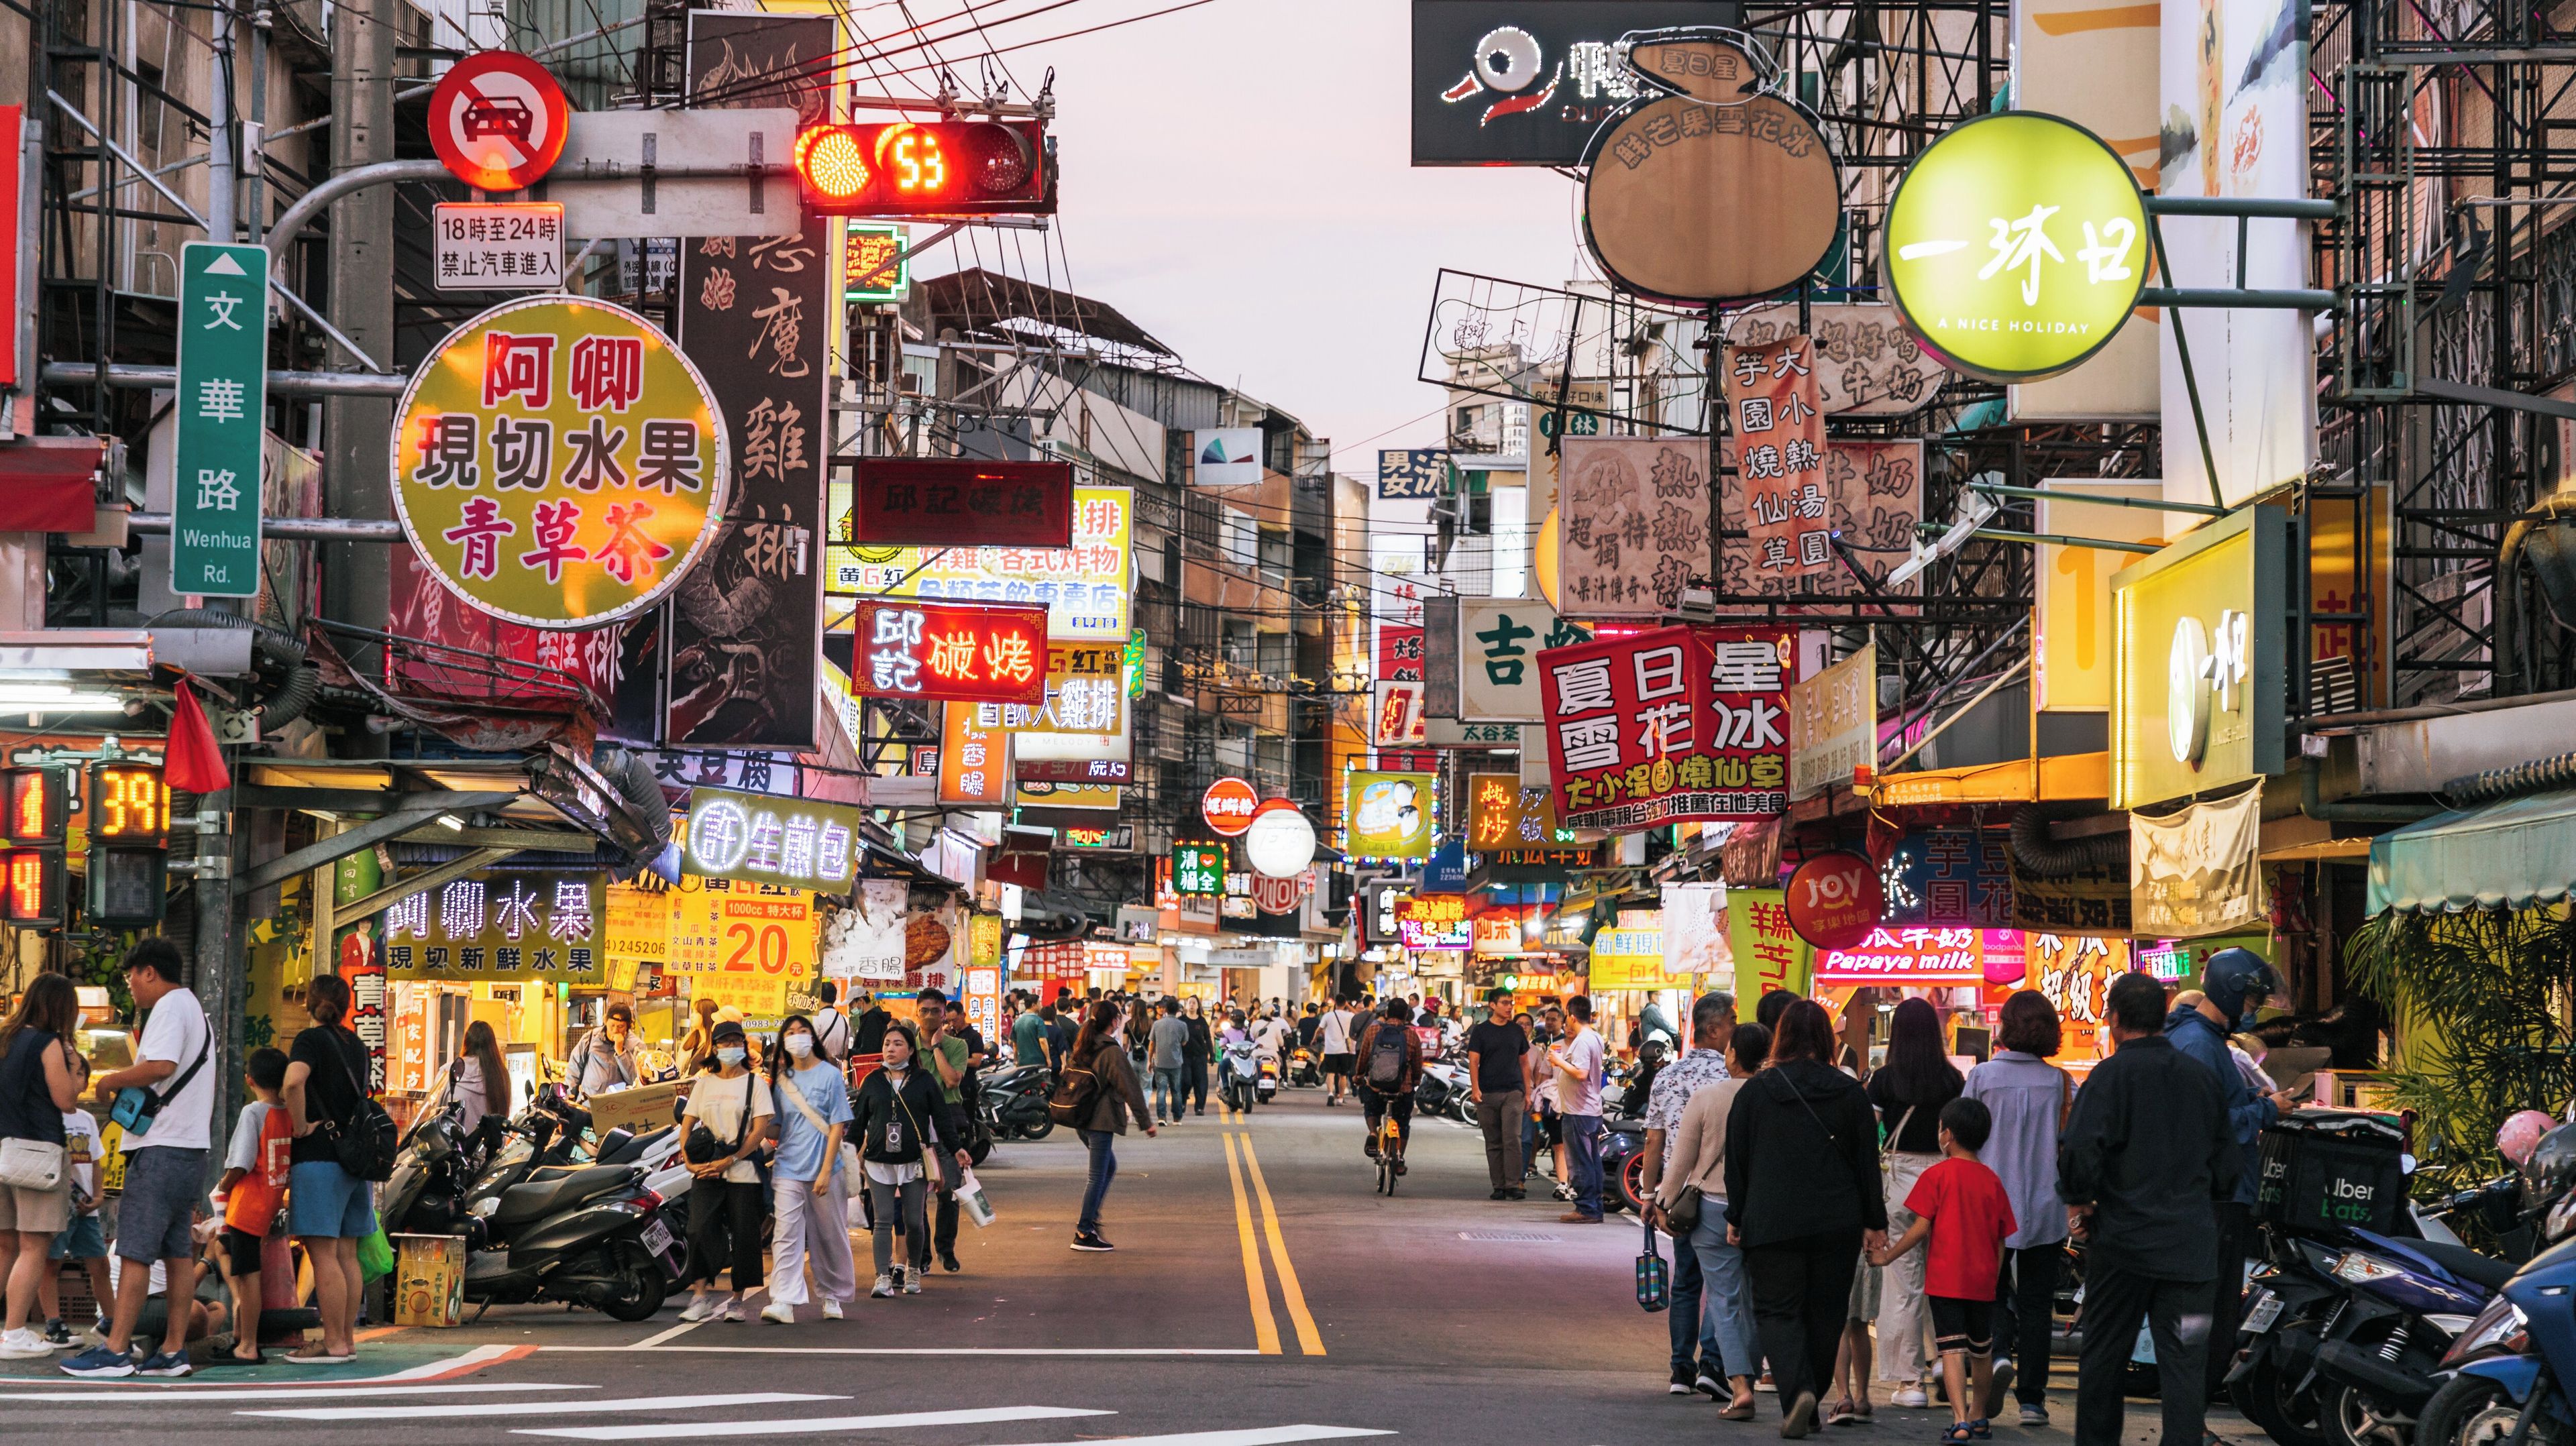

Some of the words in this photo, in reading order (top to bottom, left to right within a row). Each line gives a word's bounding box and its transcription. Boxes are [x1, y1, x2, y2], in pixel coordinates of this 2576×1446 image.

[1660, 48, 1738, 80] 夏日星
[1613, 105, 1815, 170] 鮮芒果雪花冰
[896, 136, 944, 189] 53
[441, 215, 556, 242] 18時至24時
[441, 250, 557, 277] 禁止汽車進入
[1898, 203, 2137, 307] 一沐日
[1938, 318, 1948, 329] A
[1957, 319, 2000, 331] NICE
[2008, 321, 2089, 335] HOLIDAY
[482, 331, 643, 412] 阿卿
[197, 290, 244, 512] 文華路
[414, 414, 702, 495] 現切水果
[1382, 450, 1411, 496] 男女
[1772, 346, 1831, 567] 大小熱湯圓
[183, 529, 252, 549] Wenhua
[444, 496, 672, 586] 青草茶
[203, 565, 231, 584] Rd.
[871, 608, 926, 693] 邱記
[929, 630, 1035, 683] 碳烤
[1551, 641, 1783, 716] 夏日星
[1042, 738, 1092, 746] MELODY
[1559, 698, 1785, 773] 雪花冰
[1564, 753, 1785, 810] 大小湯圓燒仙草
[729, 902, 763, 915] 1000cc
[767, 905, 804, 918] 特大杯
[1807, 867, 1862, 909] JOY
[387, 880, 594, 944] 阿卿水果
[387, 945, 594, 972] 現切新鮮水果
[672, 936, 718, 948] 文山青茶
[724, 922, 790, 976] 20
[792, 964, 802, 975] 元
[1825, 951, 1913, 973] Papaya
[1918, 950, 1976, 970] milk
[671, 960, 717, 972] 仙草甘茶
[858, 955, 902, 977] 香腸
[787, 993, 820, 1011] 不加水
[2263, 1157, 2288, 1180] Uber
